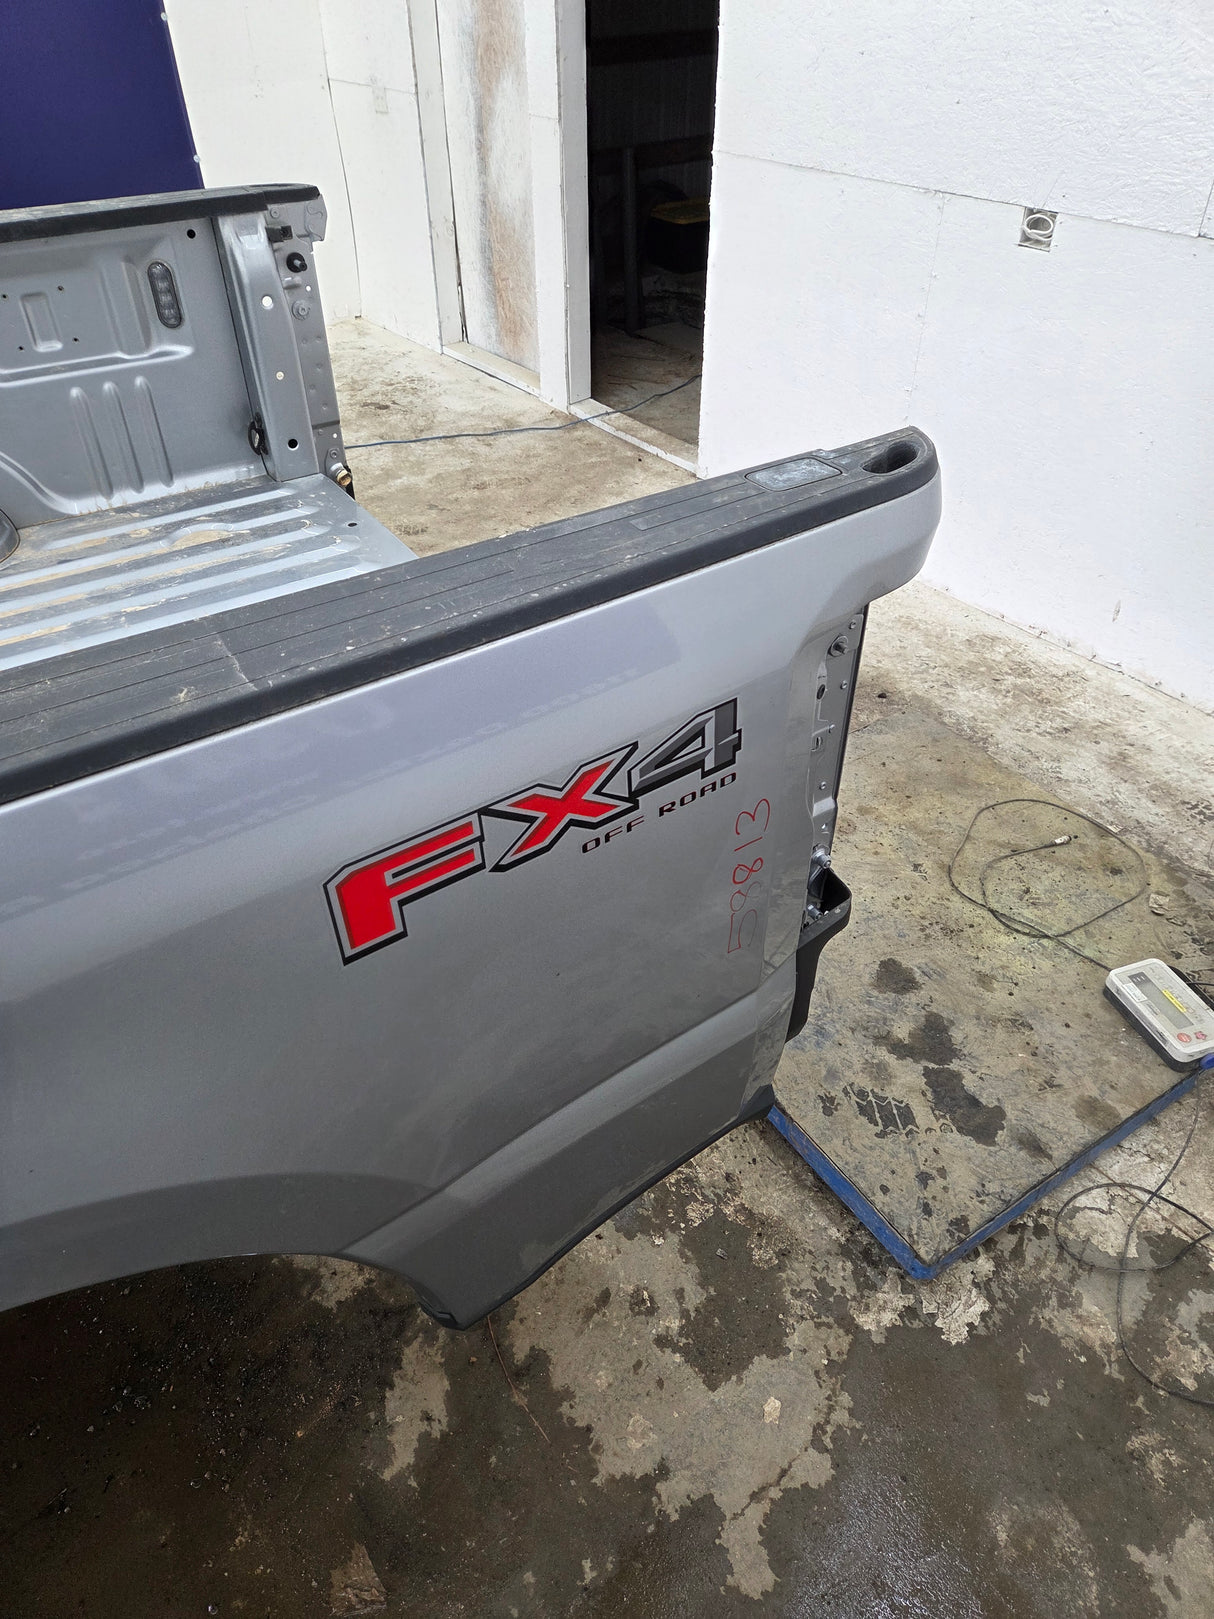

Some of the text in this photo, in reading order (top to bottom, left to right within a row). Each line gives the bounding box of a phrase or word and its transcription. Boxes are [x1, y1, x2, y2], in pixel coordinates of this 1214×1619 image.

[322, 698, 742, 966] FX4
[581, 772, 737, 854] OFF ROAD
[727, 798, 771, 954] 58813
